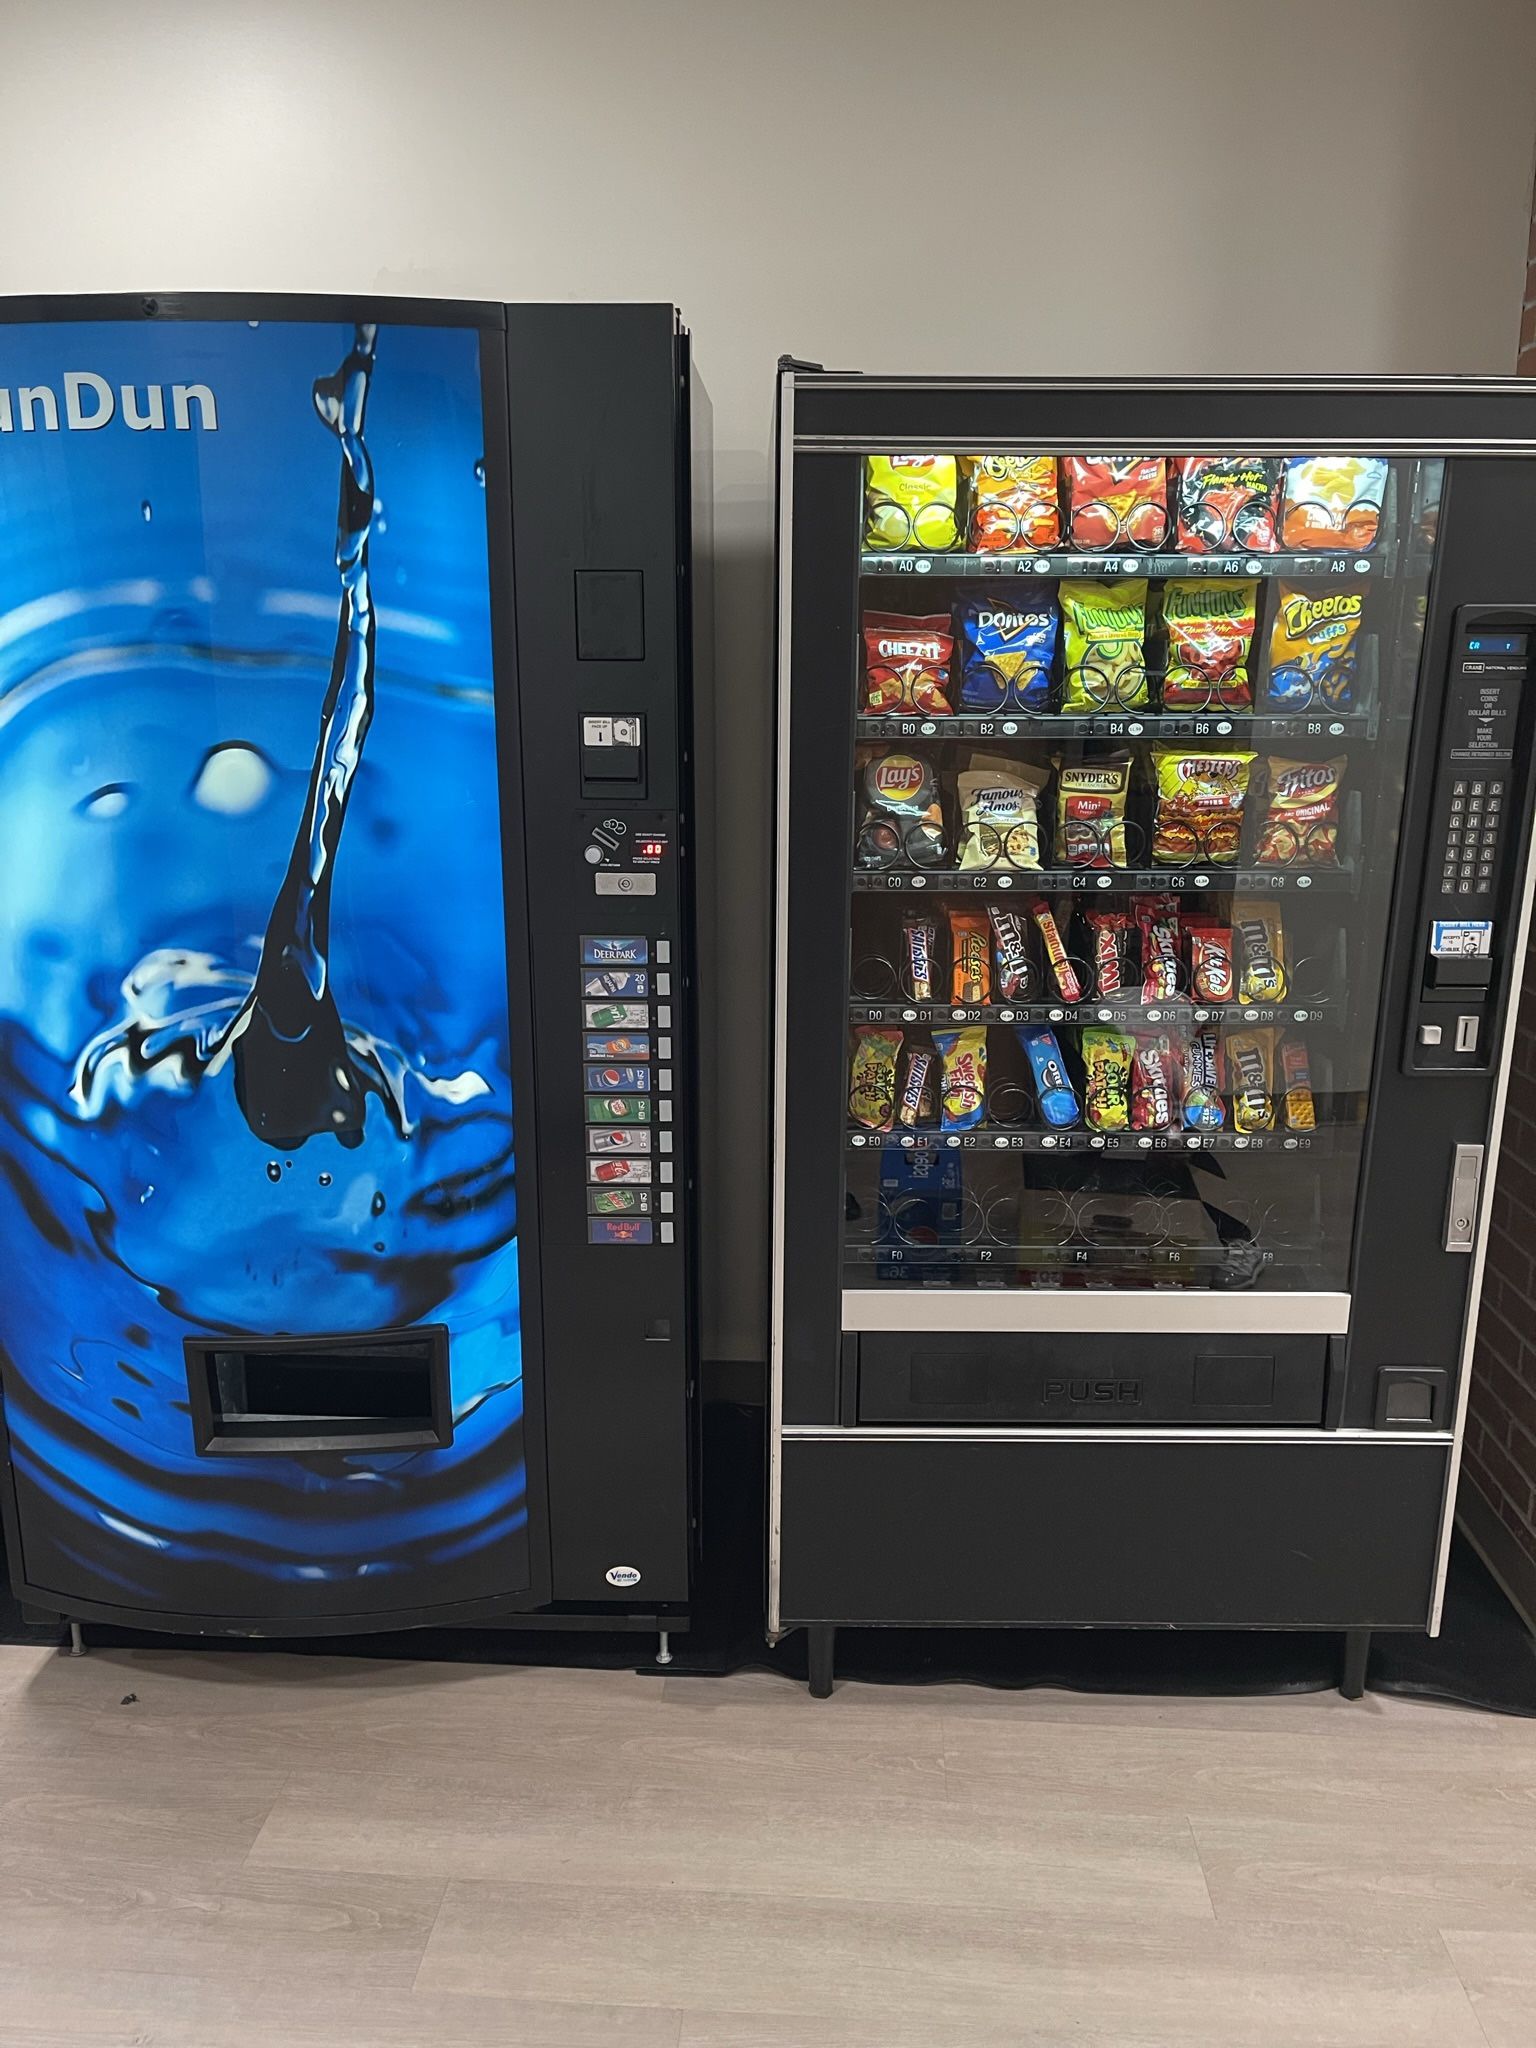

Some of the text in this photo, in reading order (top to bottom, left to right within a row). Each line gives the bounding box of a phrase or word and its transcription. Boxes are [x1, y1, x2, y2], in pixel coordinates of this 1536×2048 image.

[899, 560, 913, 572] A0
[1017, 560, 1032, 572] A2
[1104, 561, 1118, 572] A4
[1224, 561, 1239, 573] A6
[1331, 561, 1346, 573] A8
[902, 723, 915, 735] B0
[980, 723, 993, 735] B2
[1110, 723, 1123, 735] B4
[1196, 723, 1209, 735] B6
[1308, 723, 1321, 735] B8
[881, 766, 921, 789] Lay's
[1065, 771, 1119, 785] SNYDER'S
[1278, 766, 1336, 797] Fritos
[1456, 784, 1501, 793] A B C
[971, 787, 1024, 803] Famous
[1454, 800, 1498, 810] D E F
[1452, 817, 1459, 826] G
[1470, 817, 1478, 826] H
[1451, 834, 1493, 843] 1 2 3
[1448, 850, 1491, 859] 4 5 6
[1446, 866, 1489, 875] 7 8 9
[888, 877, 901, 887] C0
[974, 877, 987, 887] C2
[1073, 877, 1086, 887] C4
[1171, 877, 1184, 887] C6
[1271, 877, 1284, 887] C8
[1462, 882, 1469, 891] 0
[593, 948, 637, 959] DEER PARK
[969, 931, 987, 983] Reese's
[634, 973, 646, 982] 20
[869, 1011, 882, 1020] D0
[920, 1011, 932, 1020] D1
[968, 1011, 981, 1020] D2
[1016, 1011, 1029, 1020] D3
[1065, 1011, 1078, 1020] D4
[1114, 1011, 1127, 1020] D5
[1163, 1011, 1176, 1021] D6
[1212, 1011, 1225, 1020] D7
[1261, 1011, 1273, 1020] D8
[1310, 1011, 1323, 1020] D9
[636, 1069, 645, 1078] 12
[1105, 1061, 1122, 1107] SOUR
[638, 1100, 646, 1109] 12
[640, 1131, 647, 1139] 12
[869, 1137, 881, 1146] E0
[918, 1137, 928, 1146] E1
[964, 1137, 976, 1146] E2
[1011, 1138, 1023, 1147] E3
[1060, 1138, 1071, 1147] E4
[1107, 1138, 1119, 1147] E5
[1155, 1138, 1167, 1148] E6
[1203, 1138, 1214, 1148] E7
[1251, 1138, 1263, 1148] E8
[1299, 1138, 1311, 1148] E9
[640, 1192, 648, 1201] 12
[607, 1222, 641, 1231] Red Bull
[891, 1250, 903, 1260] F0
[980, 1251, 992, 1261] F2
[1076, 1252, 1088, 1261] F4
[1169, 1252, 1181, 1261] F6
[1043, 1381, 1140, 1403] PUSH
[609, 1571, 638, 1580] Vendo
